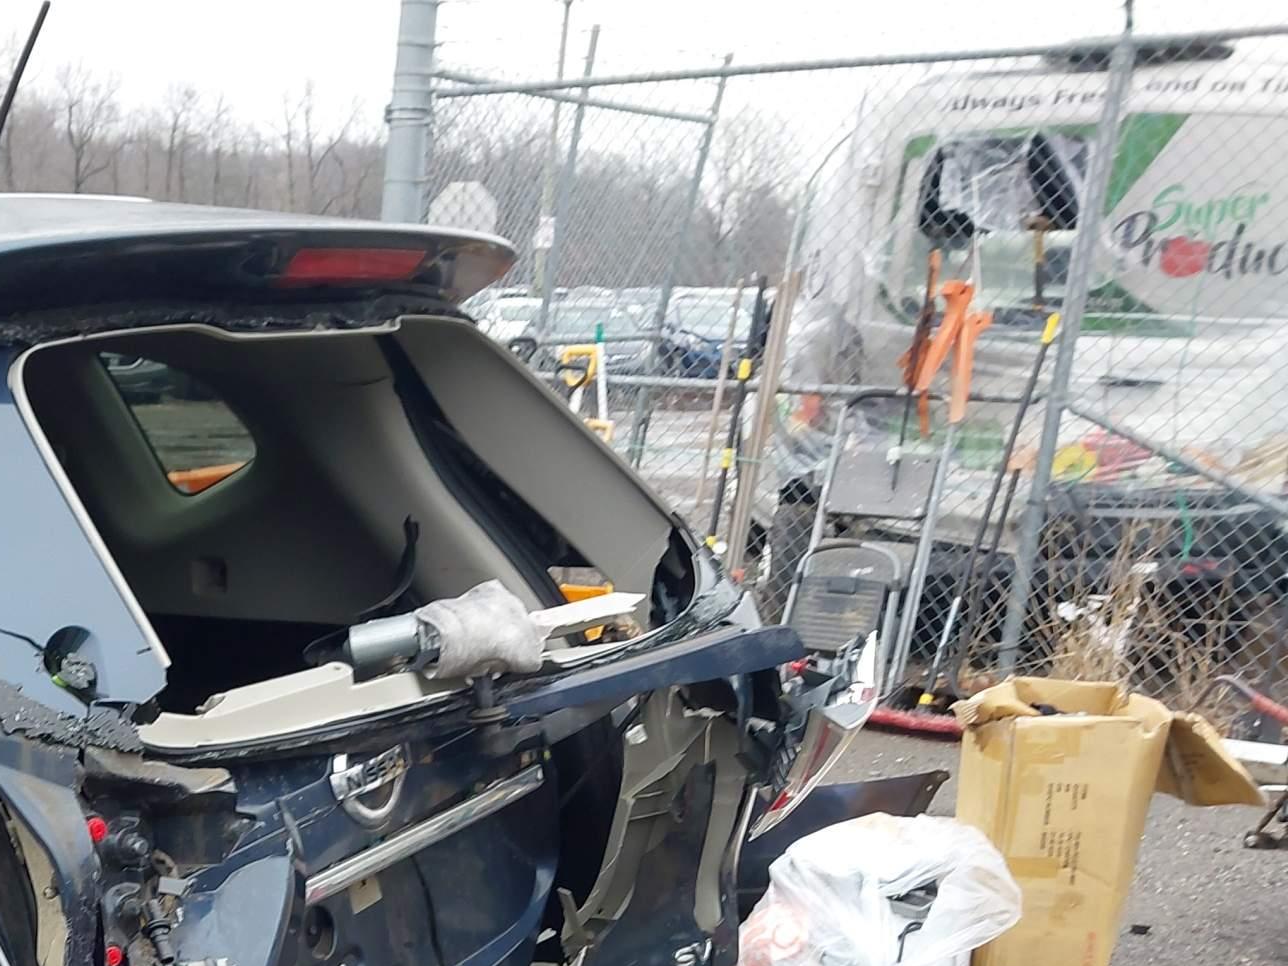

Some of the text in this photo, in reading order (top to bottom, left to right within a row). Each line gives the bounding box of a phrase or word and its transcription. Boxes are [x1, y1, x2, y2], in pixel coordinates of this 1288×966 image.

[1053, 89, 1107, 105] Fre
[1146, 73, 1204, 93] and
[1212, 80, 1247, 93] on
[1152, 183, 1271, 239] Super
